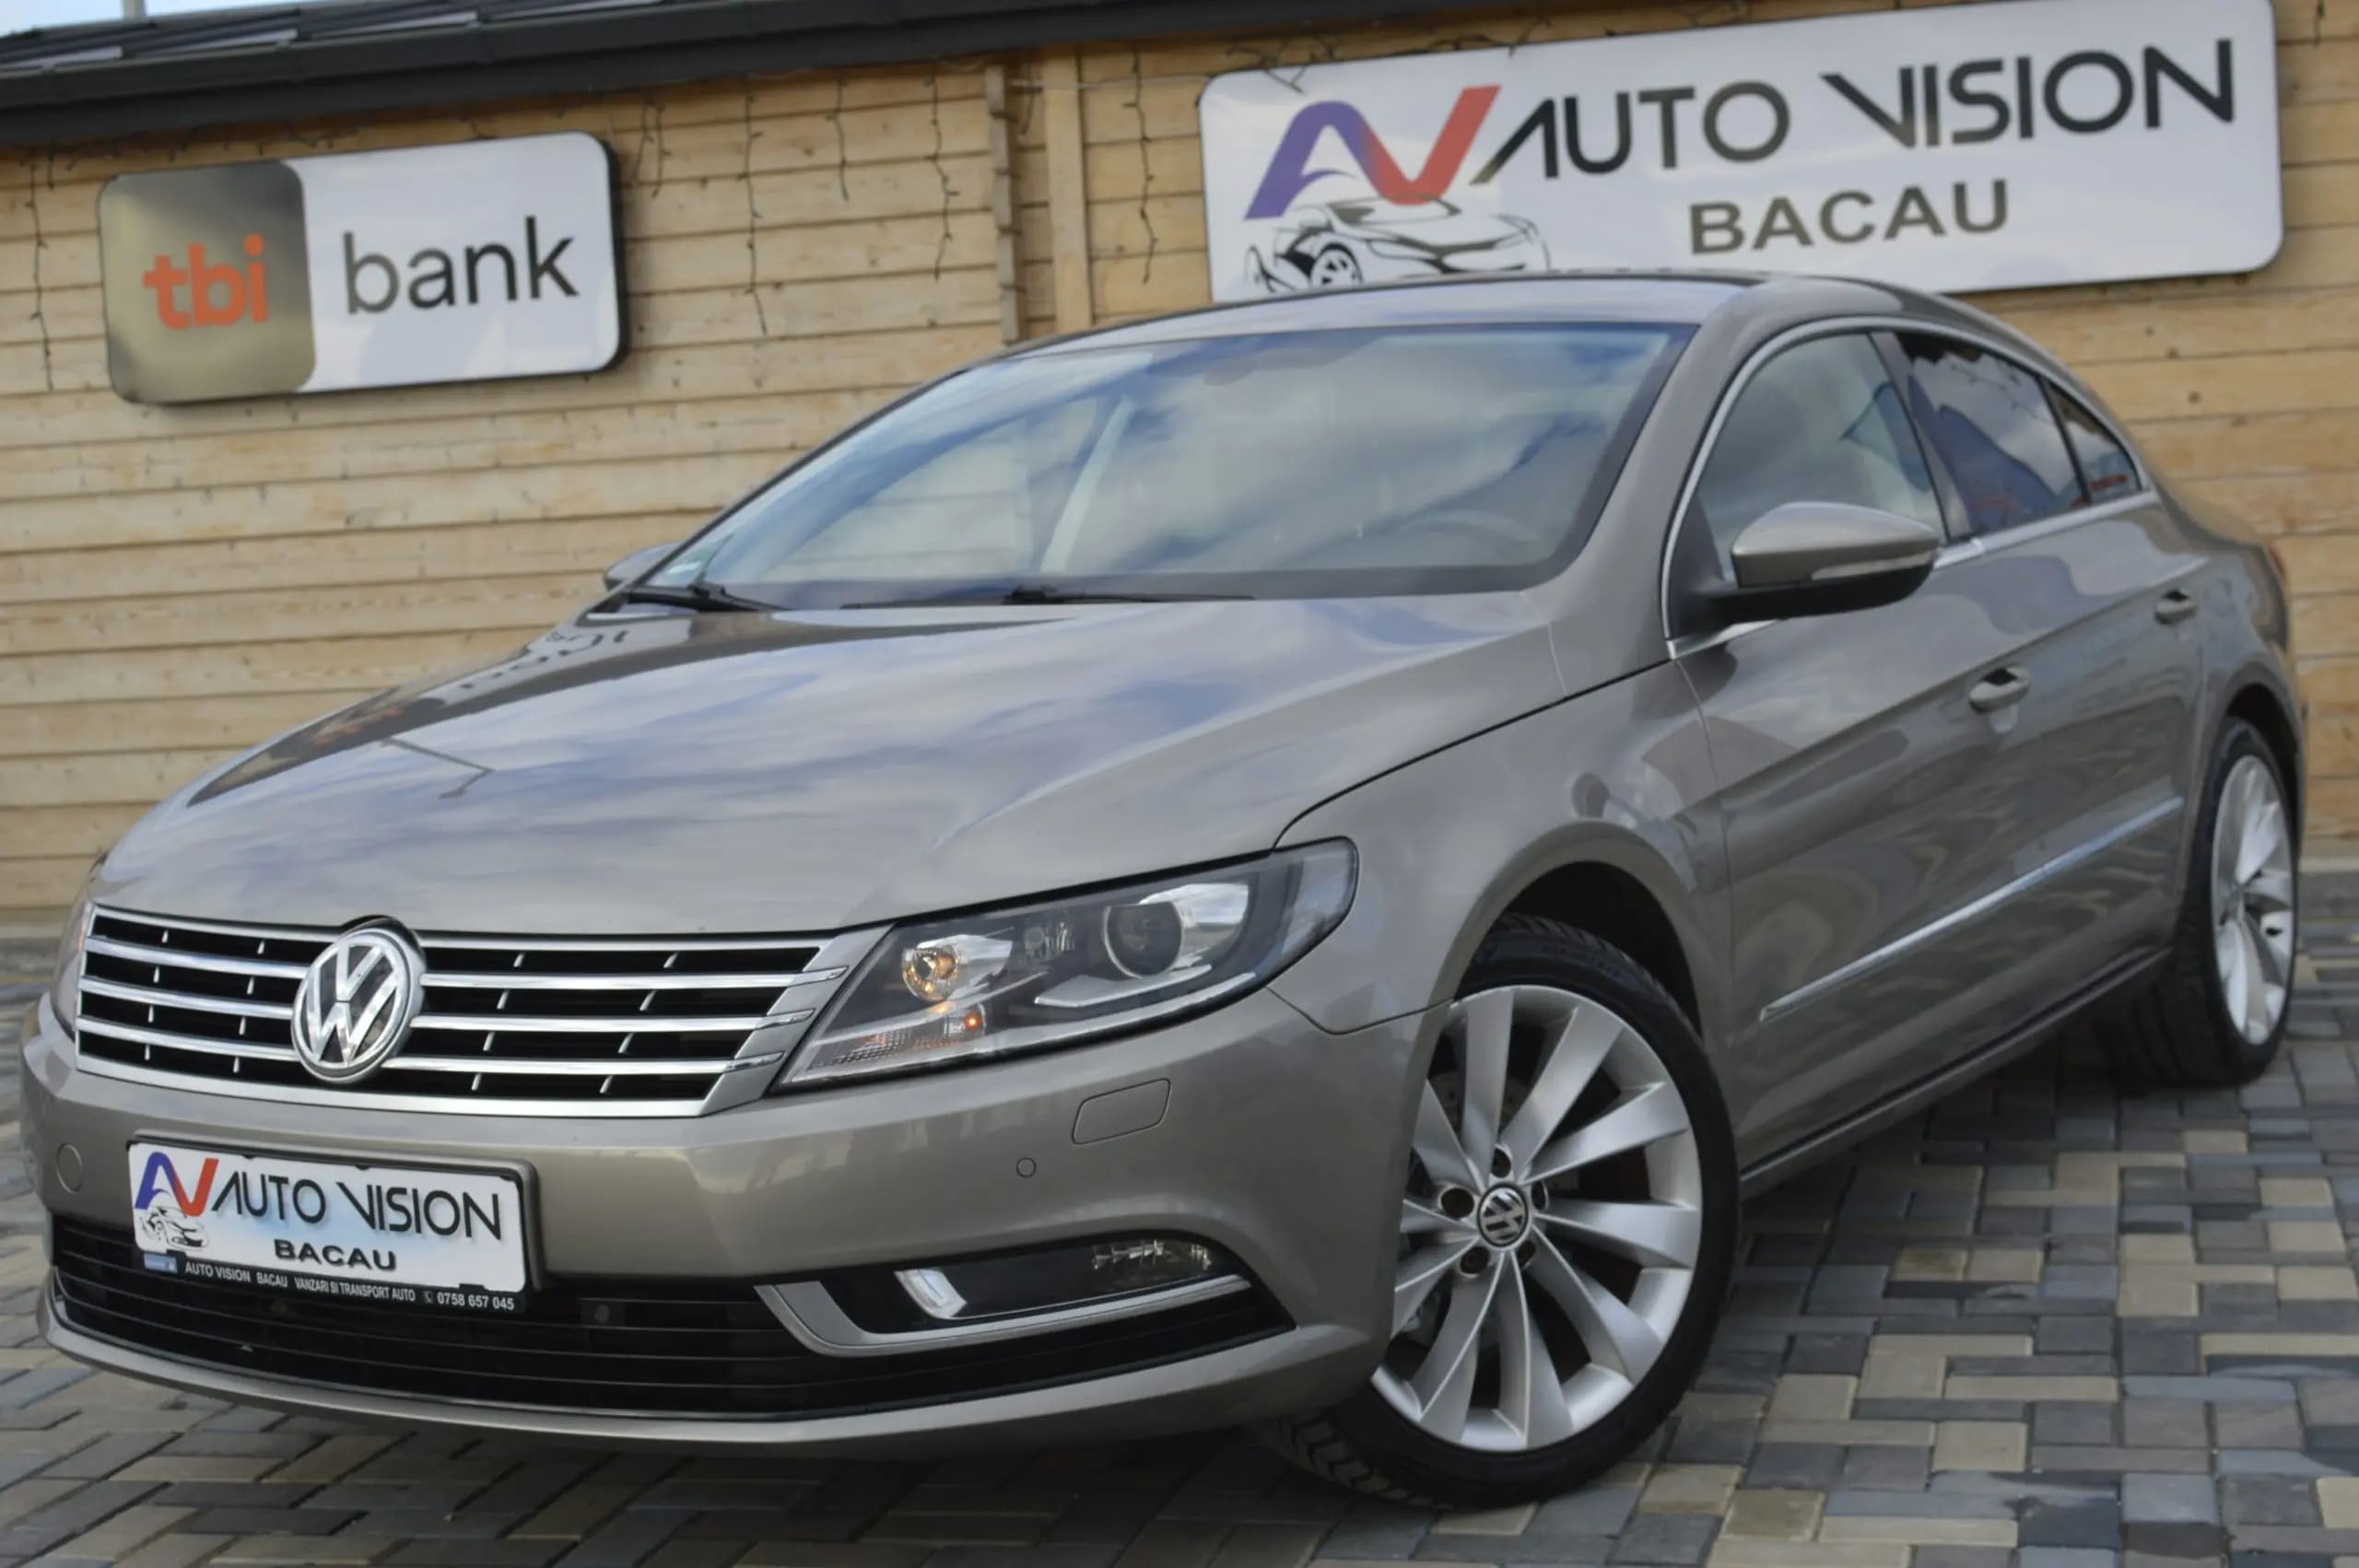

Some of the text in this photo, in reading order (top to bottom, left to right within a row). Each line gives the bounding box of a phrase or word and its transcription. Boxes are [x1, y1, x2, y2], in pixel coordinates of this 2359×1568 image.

[1470, 39, 2234, 185] AUTO VISION
[1689, 180, 2010, 255] BACAU
[142, 216, 580, 330] tbi bank
[211, 1171, 503, 1240] AUTO VISION
[185, 1261, 214, 1277] AUTO
[215, 1265, 251, 1282] VISION
[256, 1272, 288, 1287] BACAU
[294, 1277, 329, 1293] VANZARI
[339, 1281, 390, 1299] TRANSPORT
[392, 1288, 416, 1302] AUTO
[437, 1292, 464, 1306] 0758
[468, 1293, 488, 1308] 657
[492, 1296, 514, 1310] 045
[274, 1239, 397, 1271] BACAU
